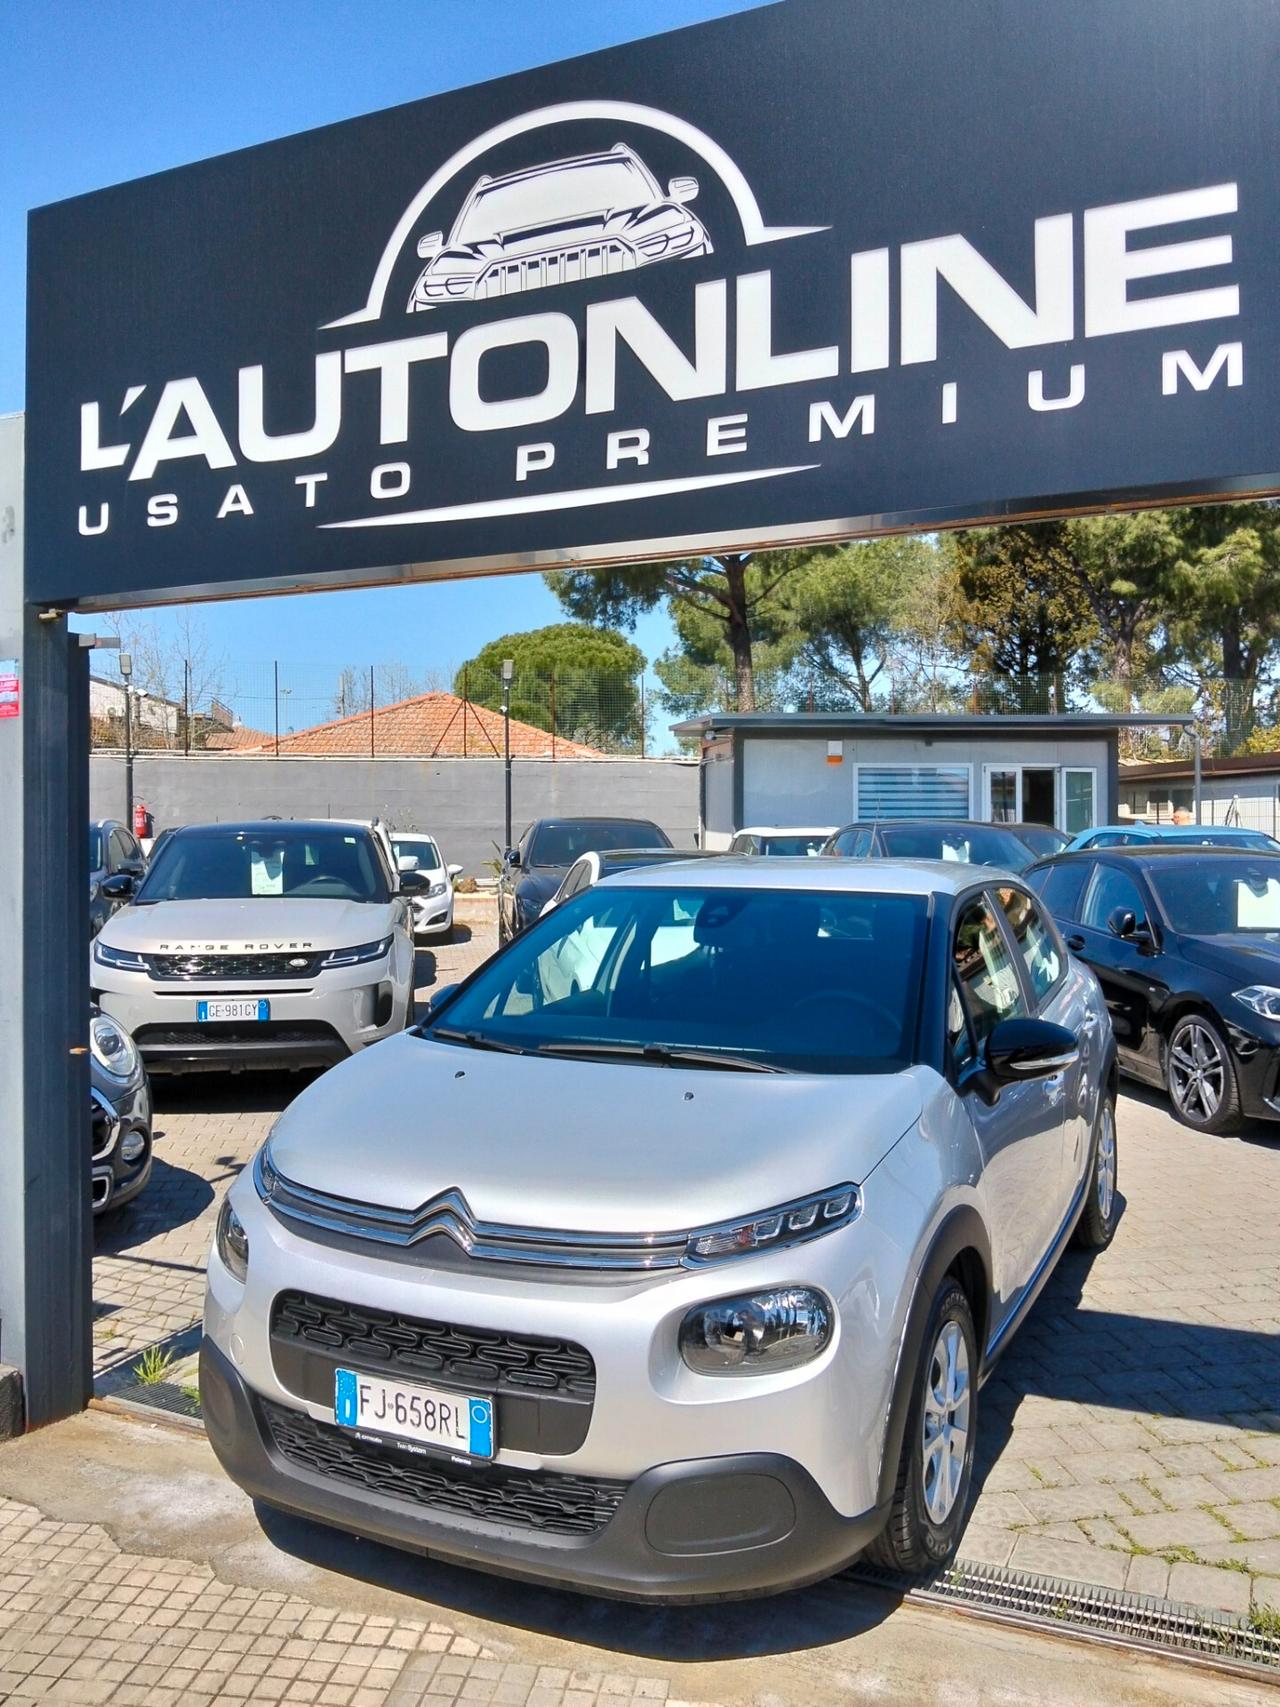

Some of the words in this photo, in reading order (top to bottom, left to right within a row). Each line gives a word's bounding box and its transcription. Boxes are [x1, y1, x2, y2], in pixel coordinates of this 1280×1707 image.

[77, 461, 412, 537] USATO
[514, 341, 1245, 483] PREMIUM
[244, 942, 313, 950] ROVER
